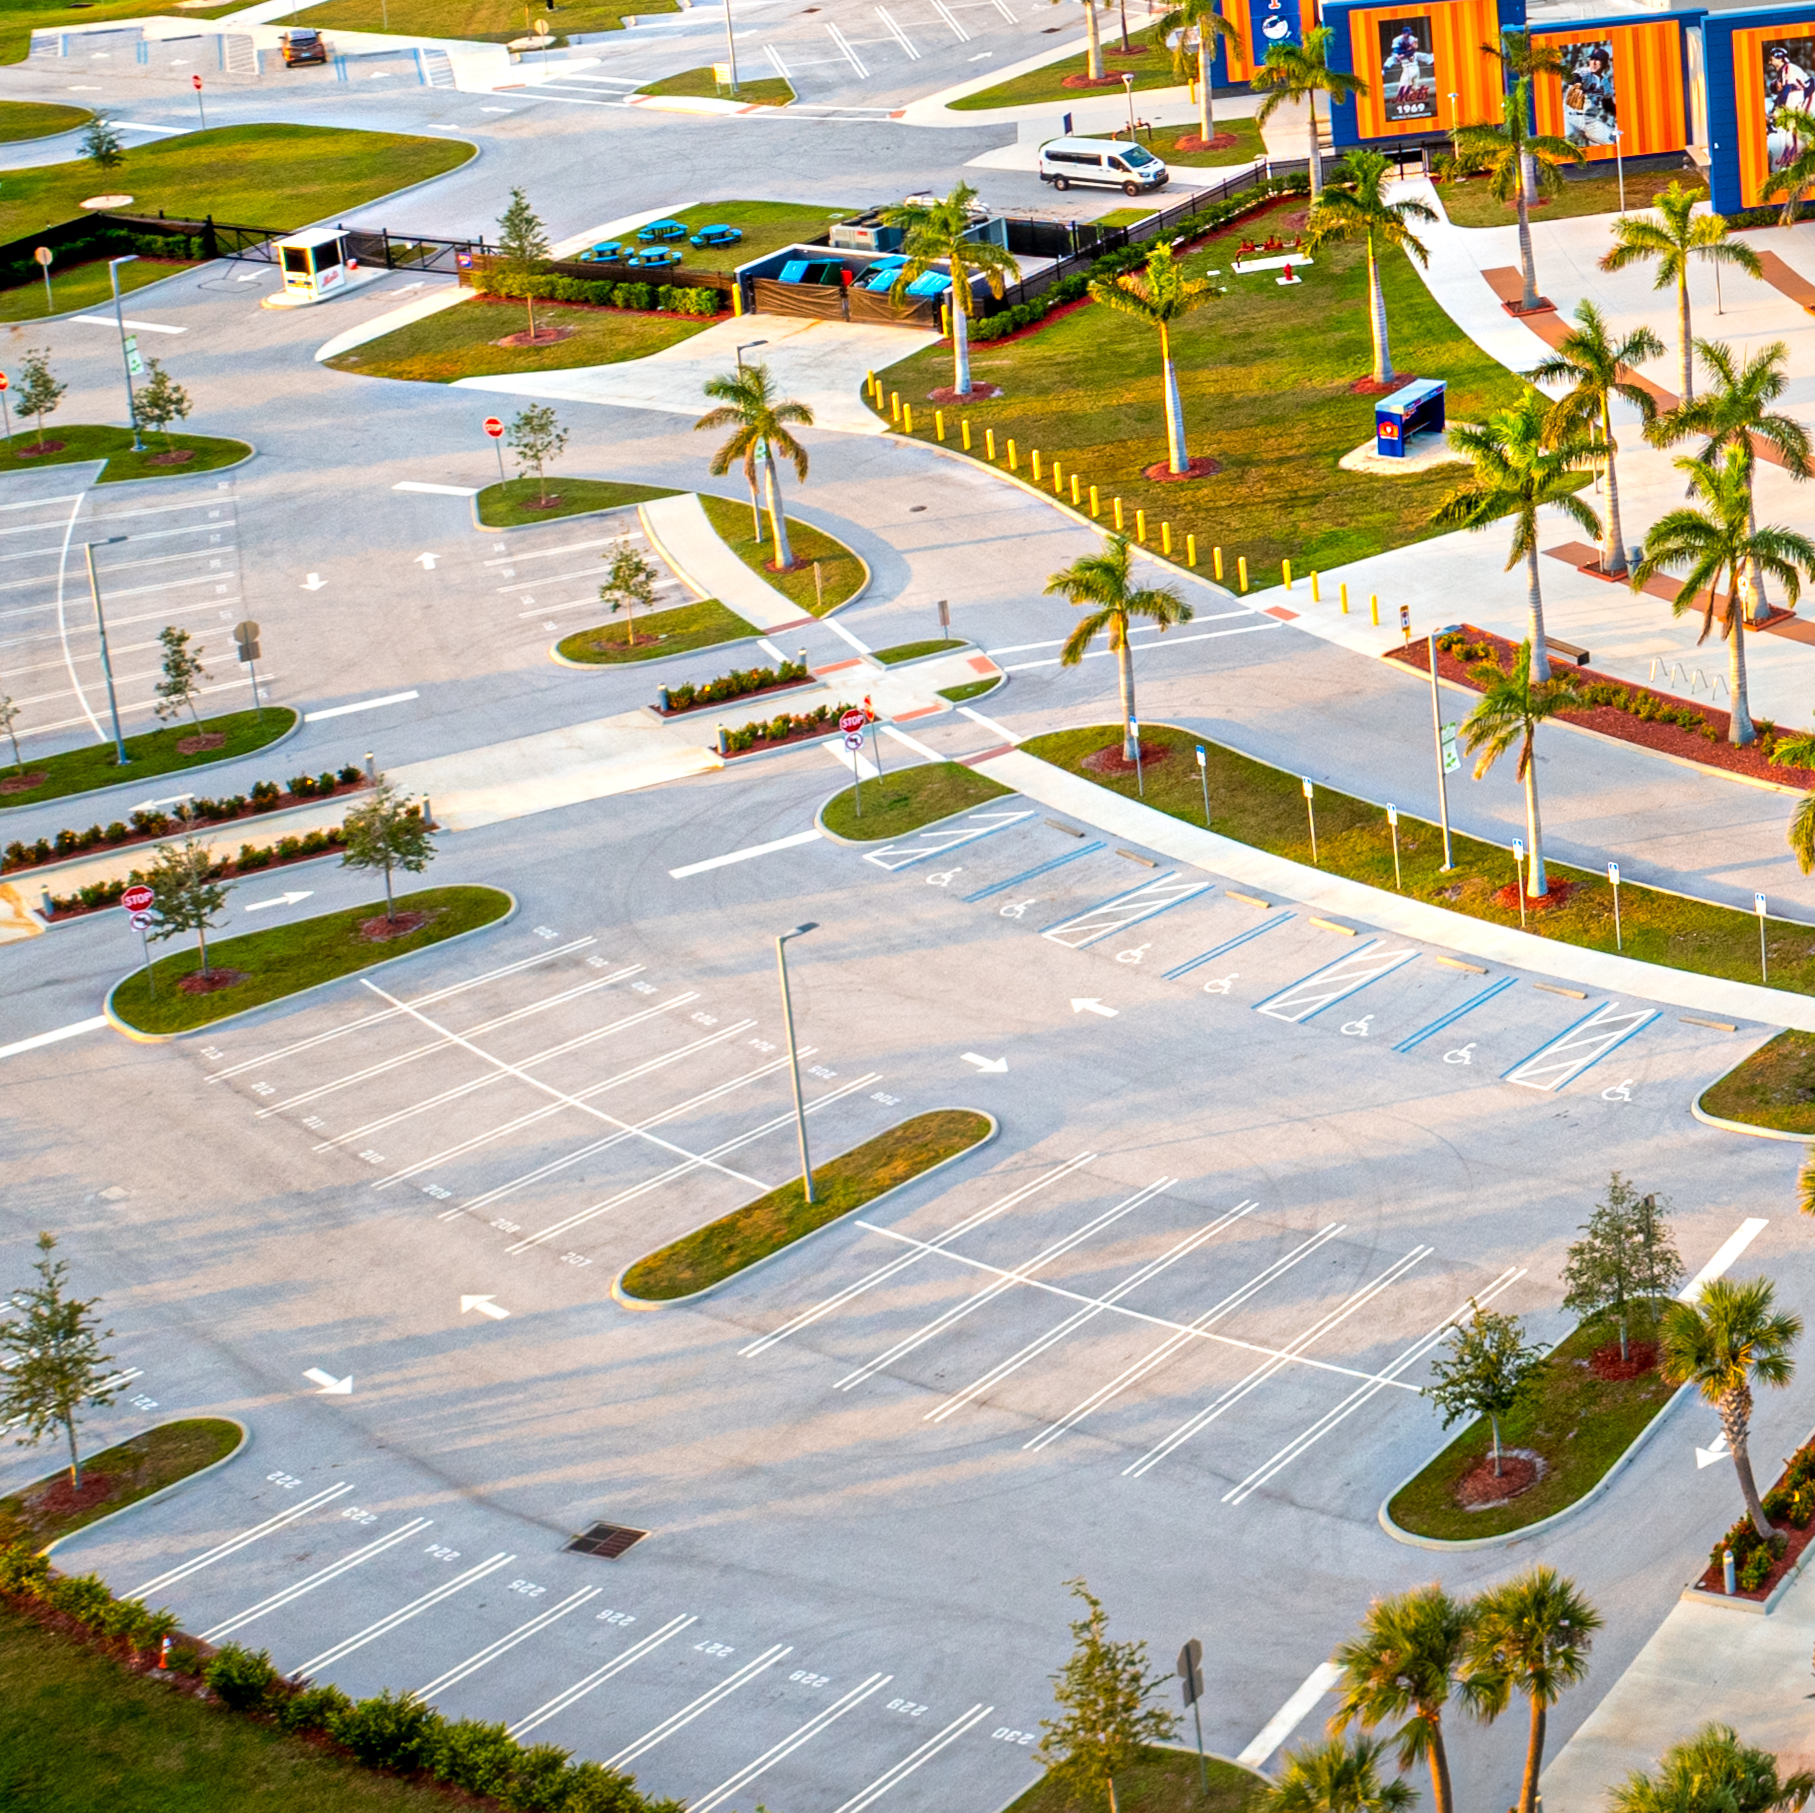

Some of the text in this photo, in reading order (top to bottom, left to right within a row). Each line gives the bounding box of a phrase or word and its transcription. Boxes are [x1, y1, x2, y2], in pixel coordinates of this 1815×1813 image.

[1391, 85, 1430, 103] Mets
[1396, 103, 1426, 114] 1969
[841, 714, 864, 728] STOP
[124, 891, 152, 906] STOP
[358, 1149, 386, 1164] 210
[422, 1184, 452, 1200] 209
[560, 1251, 593, 1268] 207
[129, 1393, 160, 1411] 221
[266, 1470, 303, 1489] 222
[341, 1506, 378, 1525] 223
[423, 1543, 461, 1562] 224
[693, 1639, 735, 1658] 227
[991, 1726, 1036, 1745] 230
